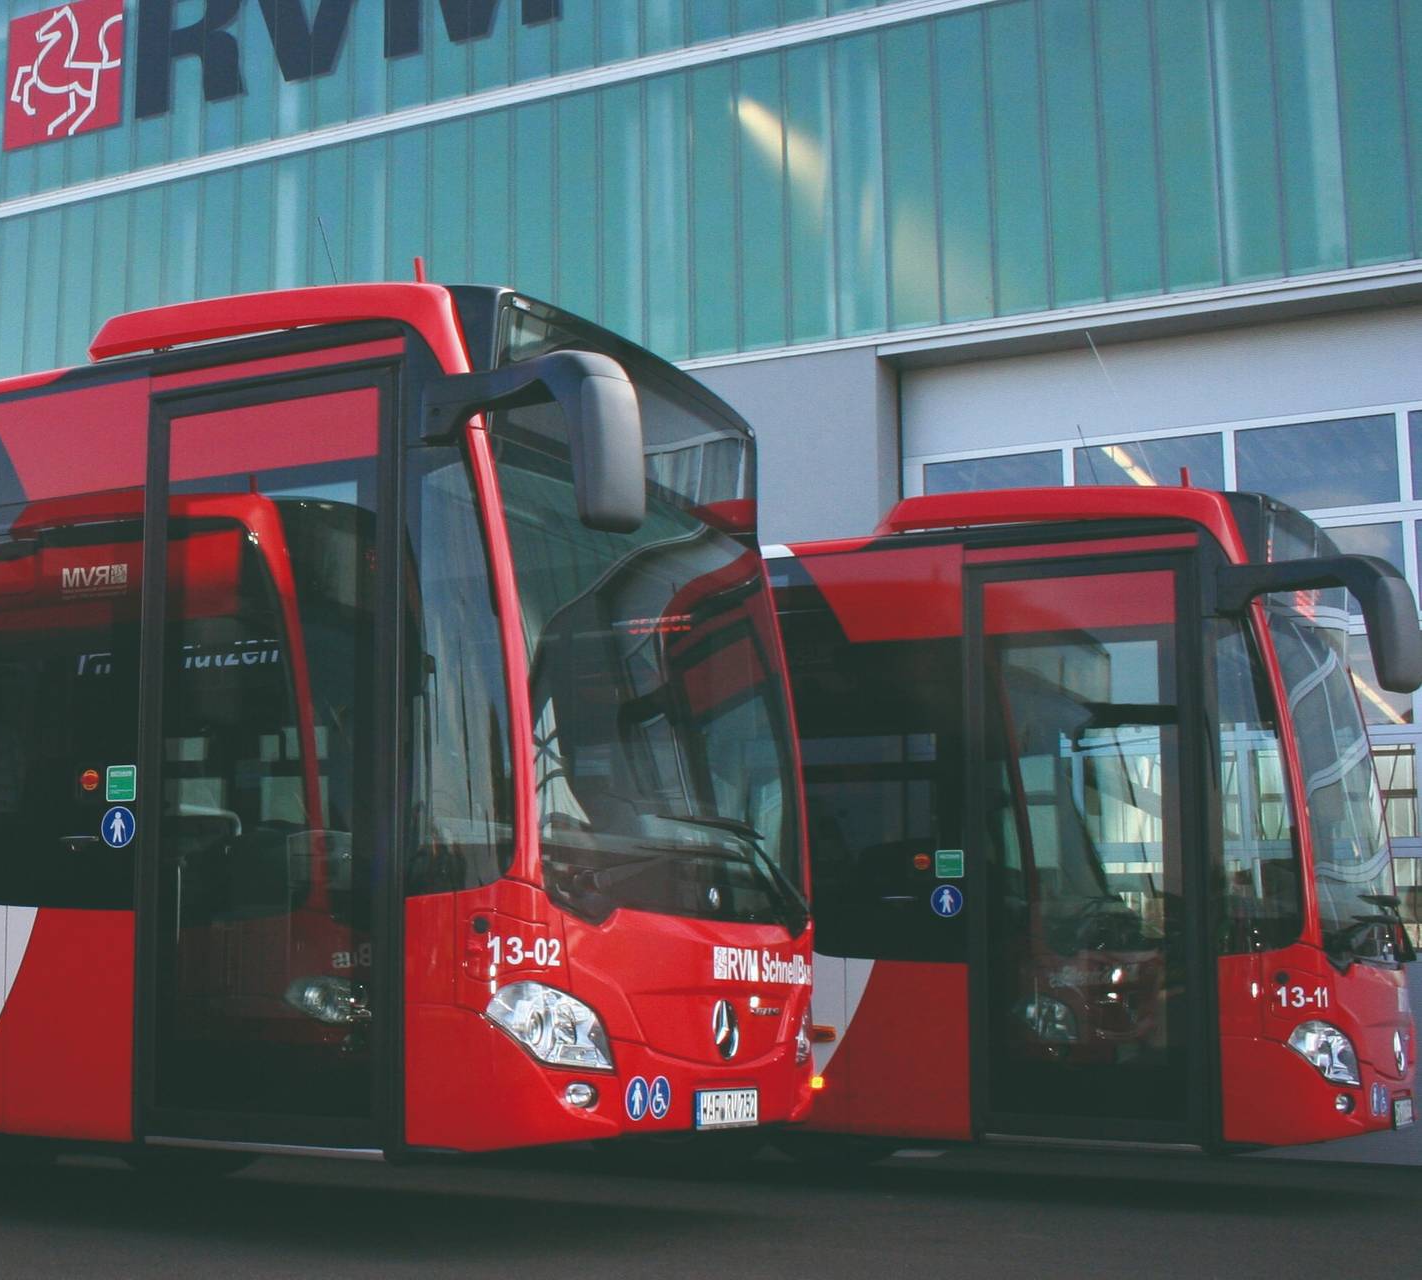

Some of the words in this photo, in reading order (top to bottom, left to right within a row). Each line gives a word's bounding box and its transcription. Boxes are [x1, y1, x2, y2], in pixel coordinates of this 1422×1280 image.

[487, 936, 561, 967] 13-02
[728, 947, 759, 982] RVM
[1277, 986, 1328, 1008] 13-11
